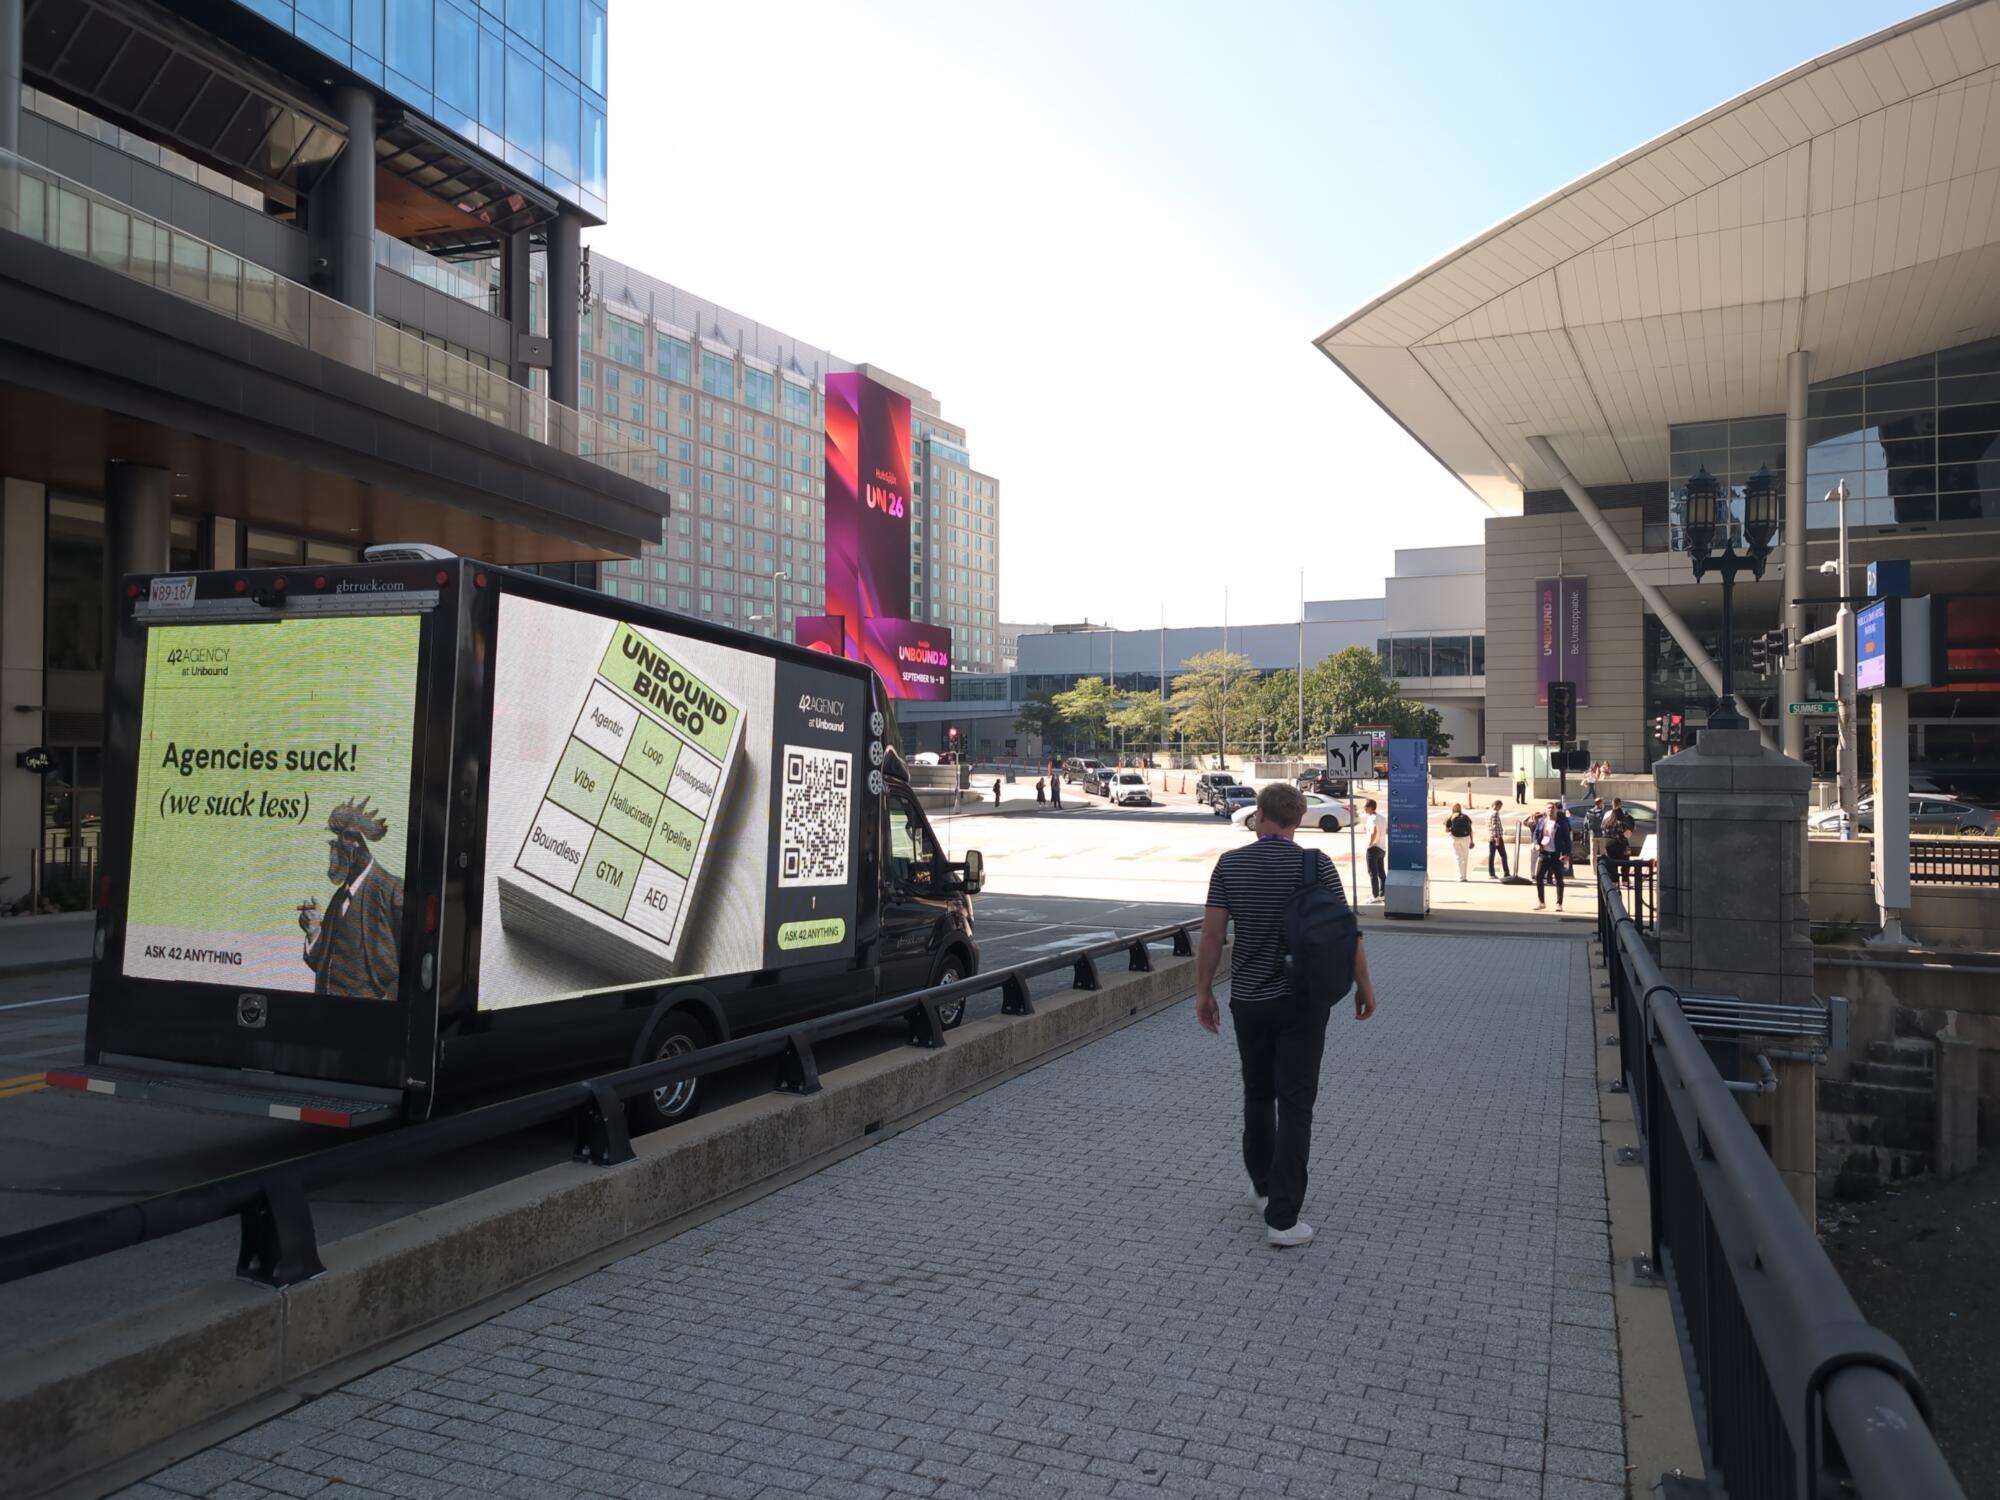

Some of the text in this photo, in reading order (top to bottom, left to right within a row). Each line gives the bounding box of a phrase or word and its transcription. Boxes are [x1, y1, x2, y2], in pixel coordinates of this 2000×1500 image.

[866, 483, 904, 519] UN 26
[335, 579, 404, 595] gbtruck.com
[1543, 603, 1553, 656] UNBOUND
[898, 645, 948, 666] UNBOUND 26
[1570, 644, 1579, 655] Be
[191, 665, 229, 676] Unbound
[622, 633, 727, 725] UNBOUND
[902, 671, 930, 684] SEPTEMBER
[632, 670, 704, 736] BINGO
[1792, 703, 1824, 713] SUMMER
[590, 706, 624, 738] Agentic
[808, 717, 845, 733] at Unbound
[162, 741, 357, 777] Agencies suck!
[642, 740, 664, 765] Loop
[573, 766, 596, 793] Vibe
[675, 763, 713, 798] Unstoppable
[1329, 769, 1349, 777] ONLY
[159, 787, 310, 825] (we suck less)
[609, 791, 653, 829] Hallucinate
[531, 825, 581, 864] Boundless
[660, 821, 692, 852] Pipeline
[595, 860, 624, 888] GTM
[643, 886, 669, 912] AEO
[784, 926, 839, 942] ASK 42 ANYTHING
[144, 945, 243, 965] ASK 42 ANYTHING
